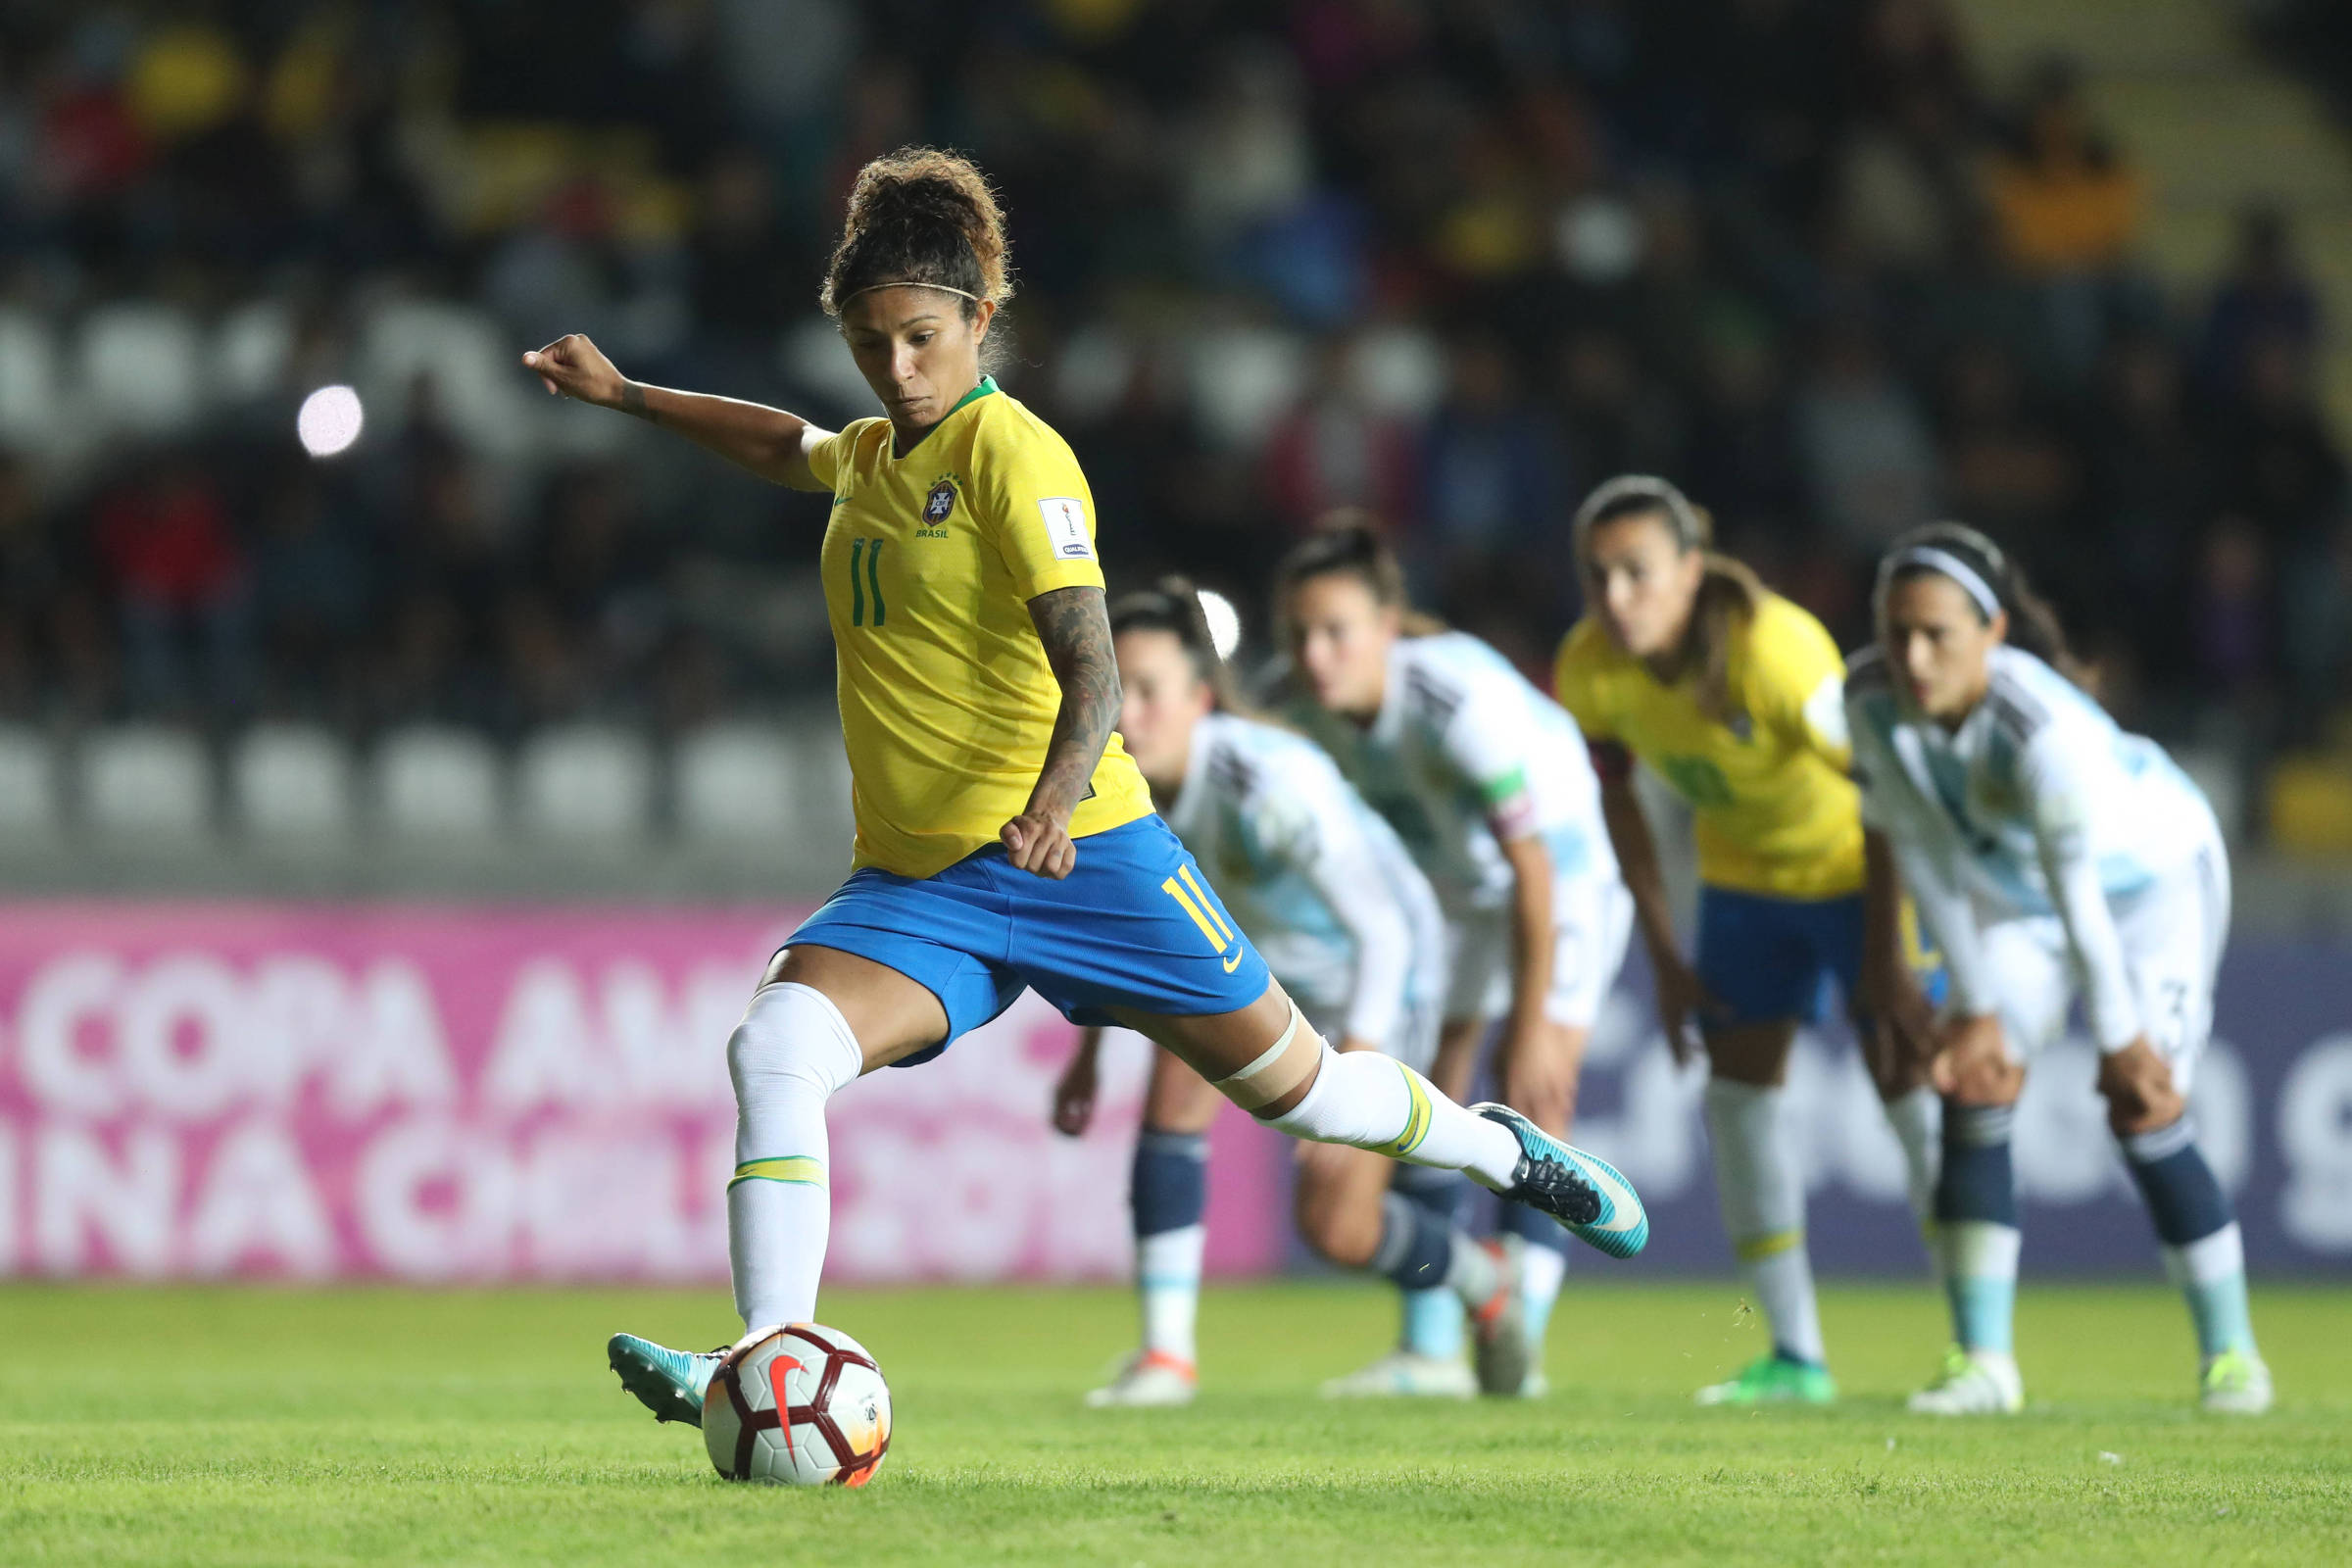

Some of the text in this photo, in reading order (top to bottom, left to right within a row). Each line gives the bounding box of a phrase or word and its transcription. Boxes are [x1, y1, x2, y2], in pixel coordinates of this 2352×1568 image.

[916, 529, 949, 539] BRASIL
[851, 537, 885, 627] 11
[1161, 863, 1235, 955] 11
[20, 951, 454, 1113] COPA
[358, 1115, 731, 1277] CHIL
